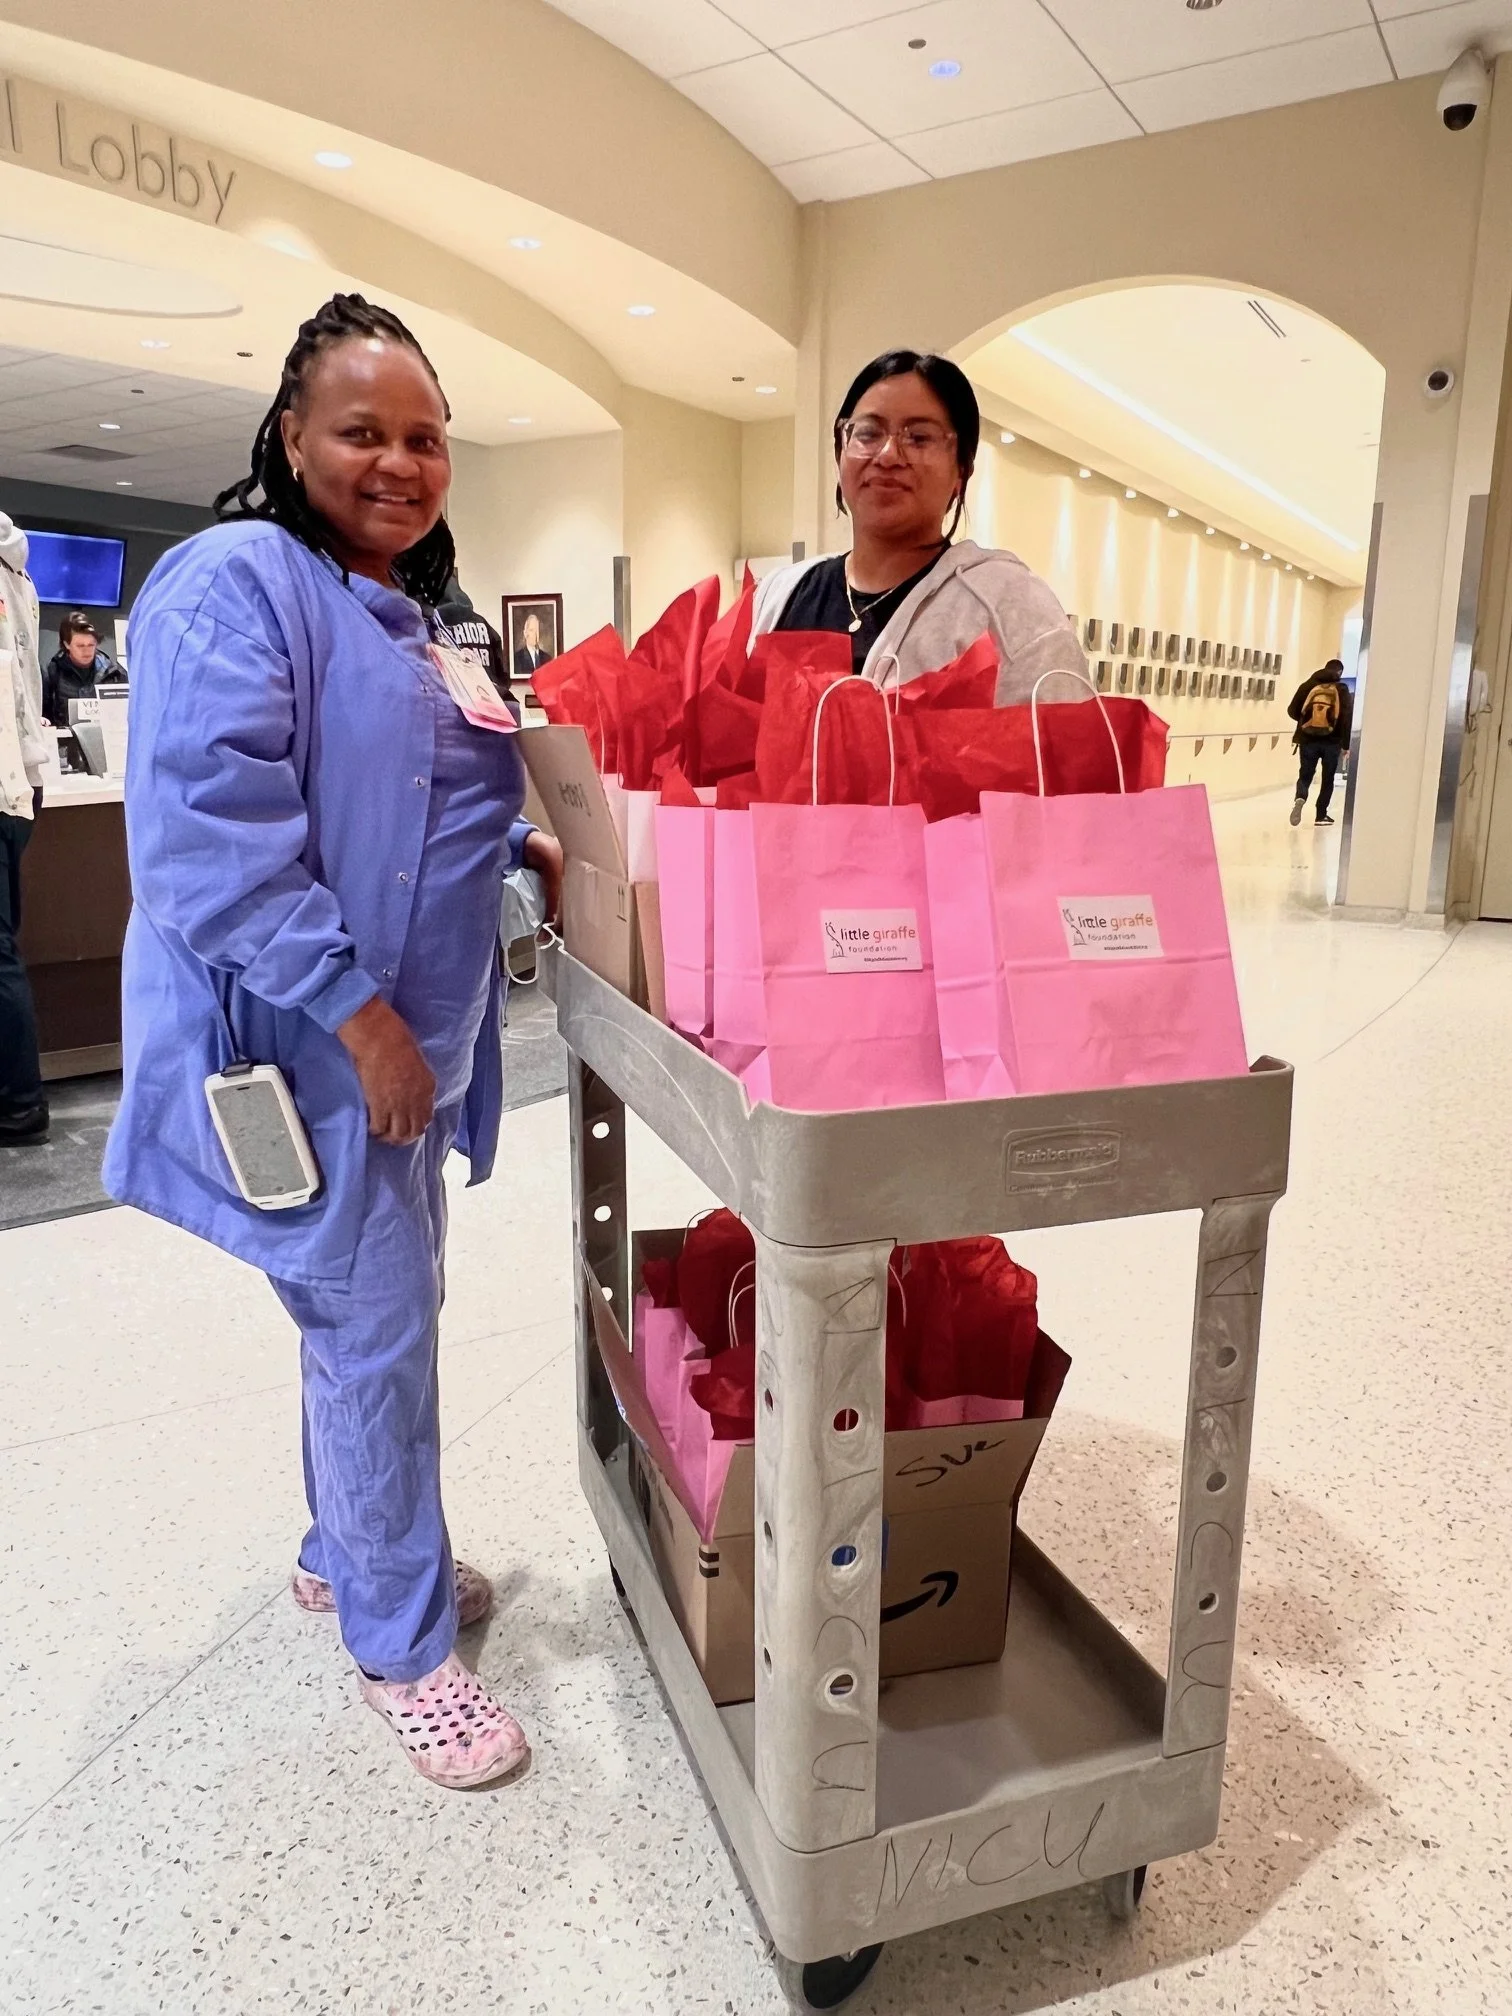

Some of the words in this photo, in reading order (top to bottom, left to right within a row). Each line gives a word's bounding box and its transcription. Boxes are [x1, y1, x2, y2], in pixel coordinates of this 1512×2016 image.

[55, 100, 237, 225] Lobby
[1077, 915, 1107, 929] little
[1110, 913, 1154, 932] giraffe
[840, 927, 870, 941] little
[872, 925, 916, 943] giraffe
[1087, 933, 1137, 942] foundation
[848, 945, 898, 953] foundation
[875, 1801, 1106, 1917] NICU
